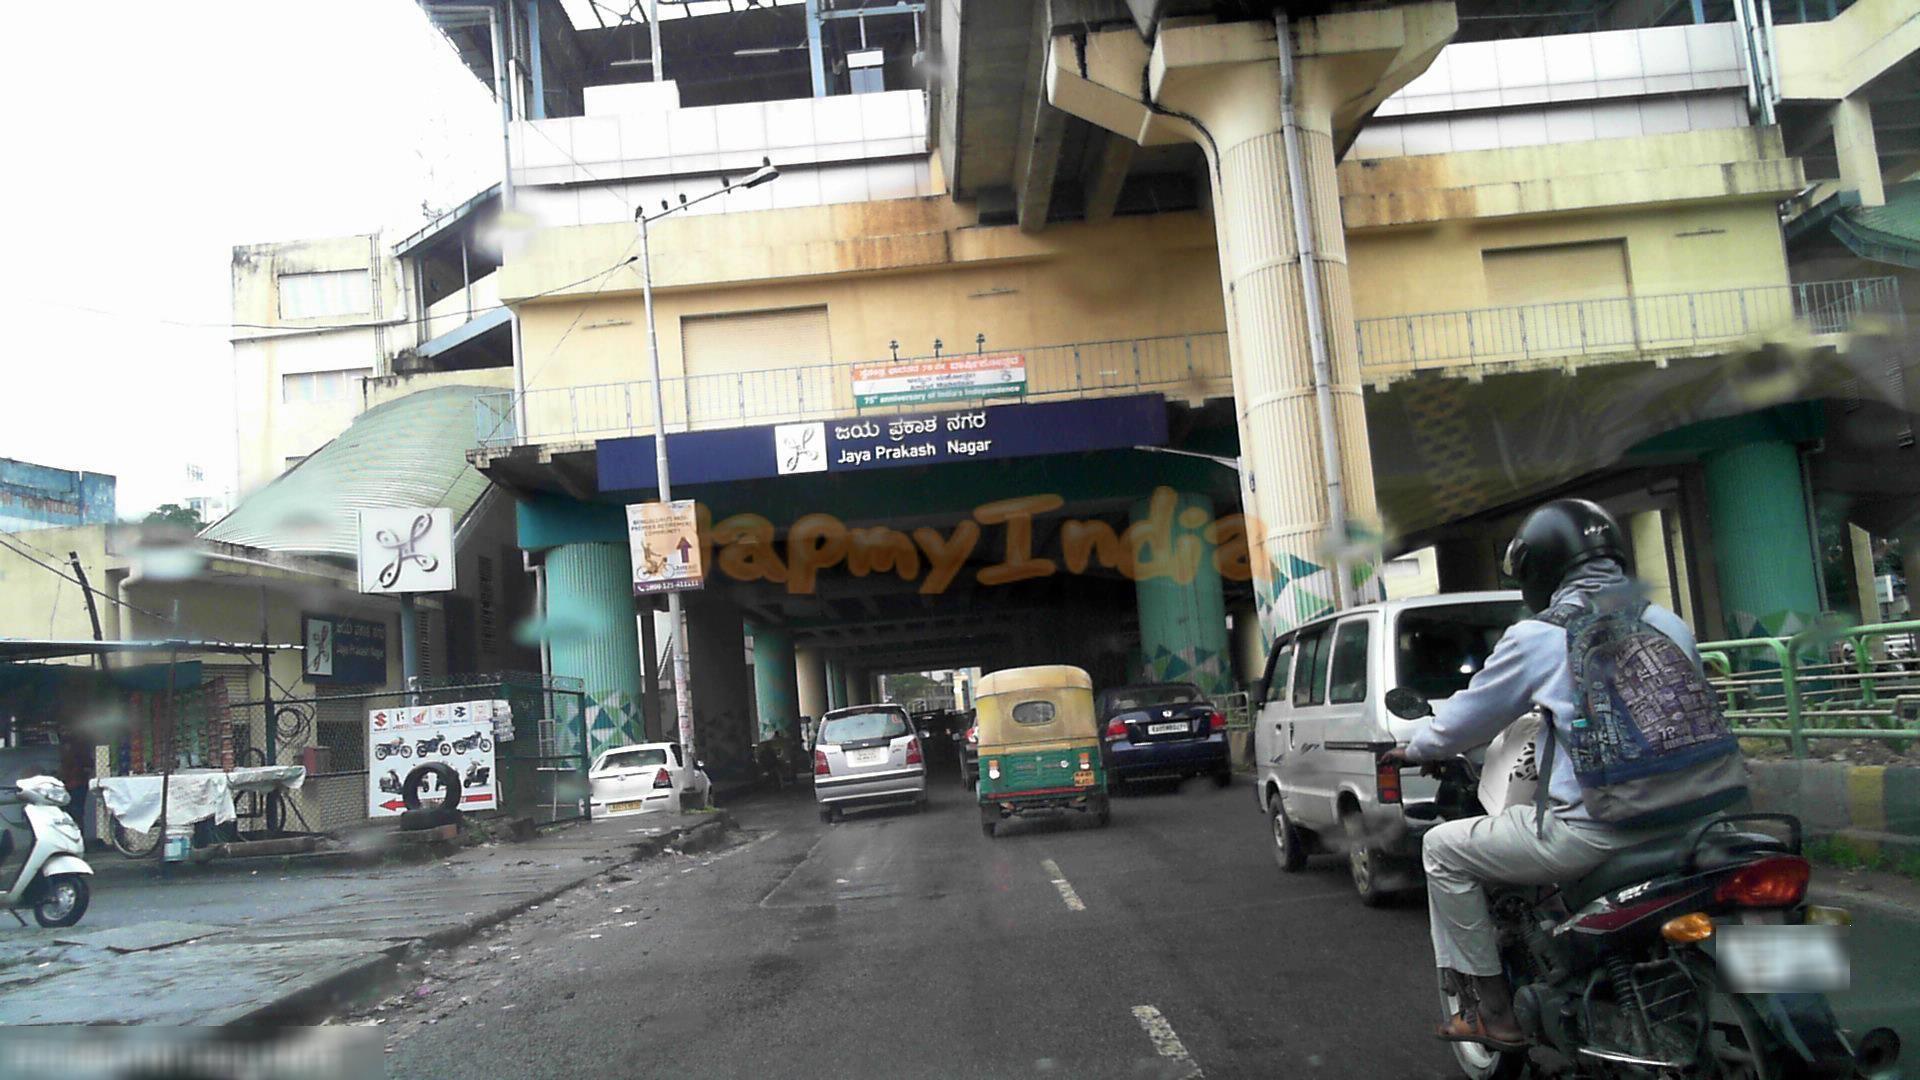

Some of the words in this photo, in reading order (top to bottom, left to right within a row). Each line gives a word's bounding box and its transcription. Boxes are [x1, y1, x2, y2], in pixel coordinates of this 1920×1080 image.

[946, 410, 987, 432] ನಗರ
[837, 449, 872, 466] Jaya
[875, 442, 937, 460] Prakash
[947, 439, 992, 456] Nagar
